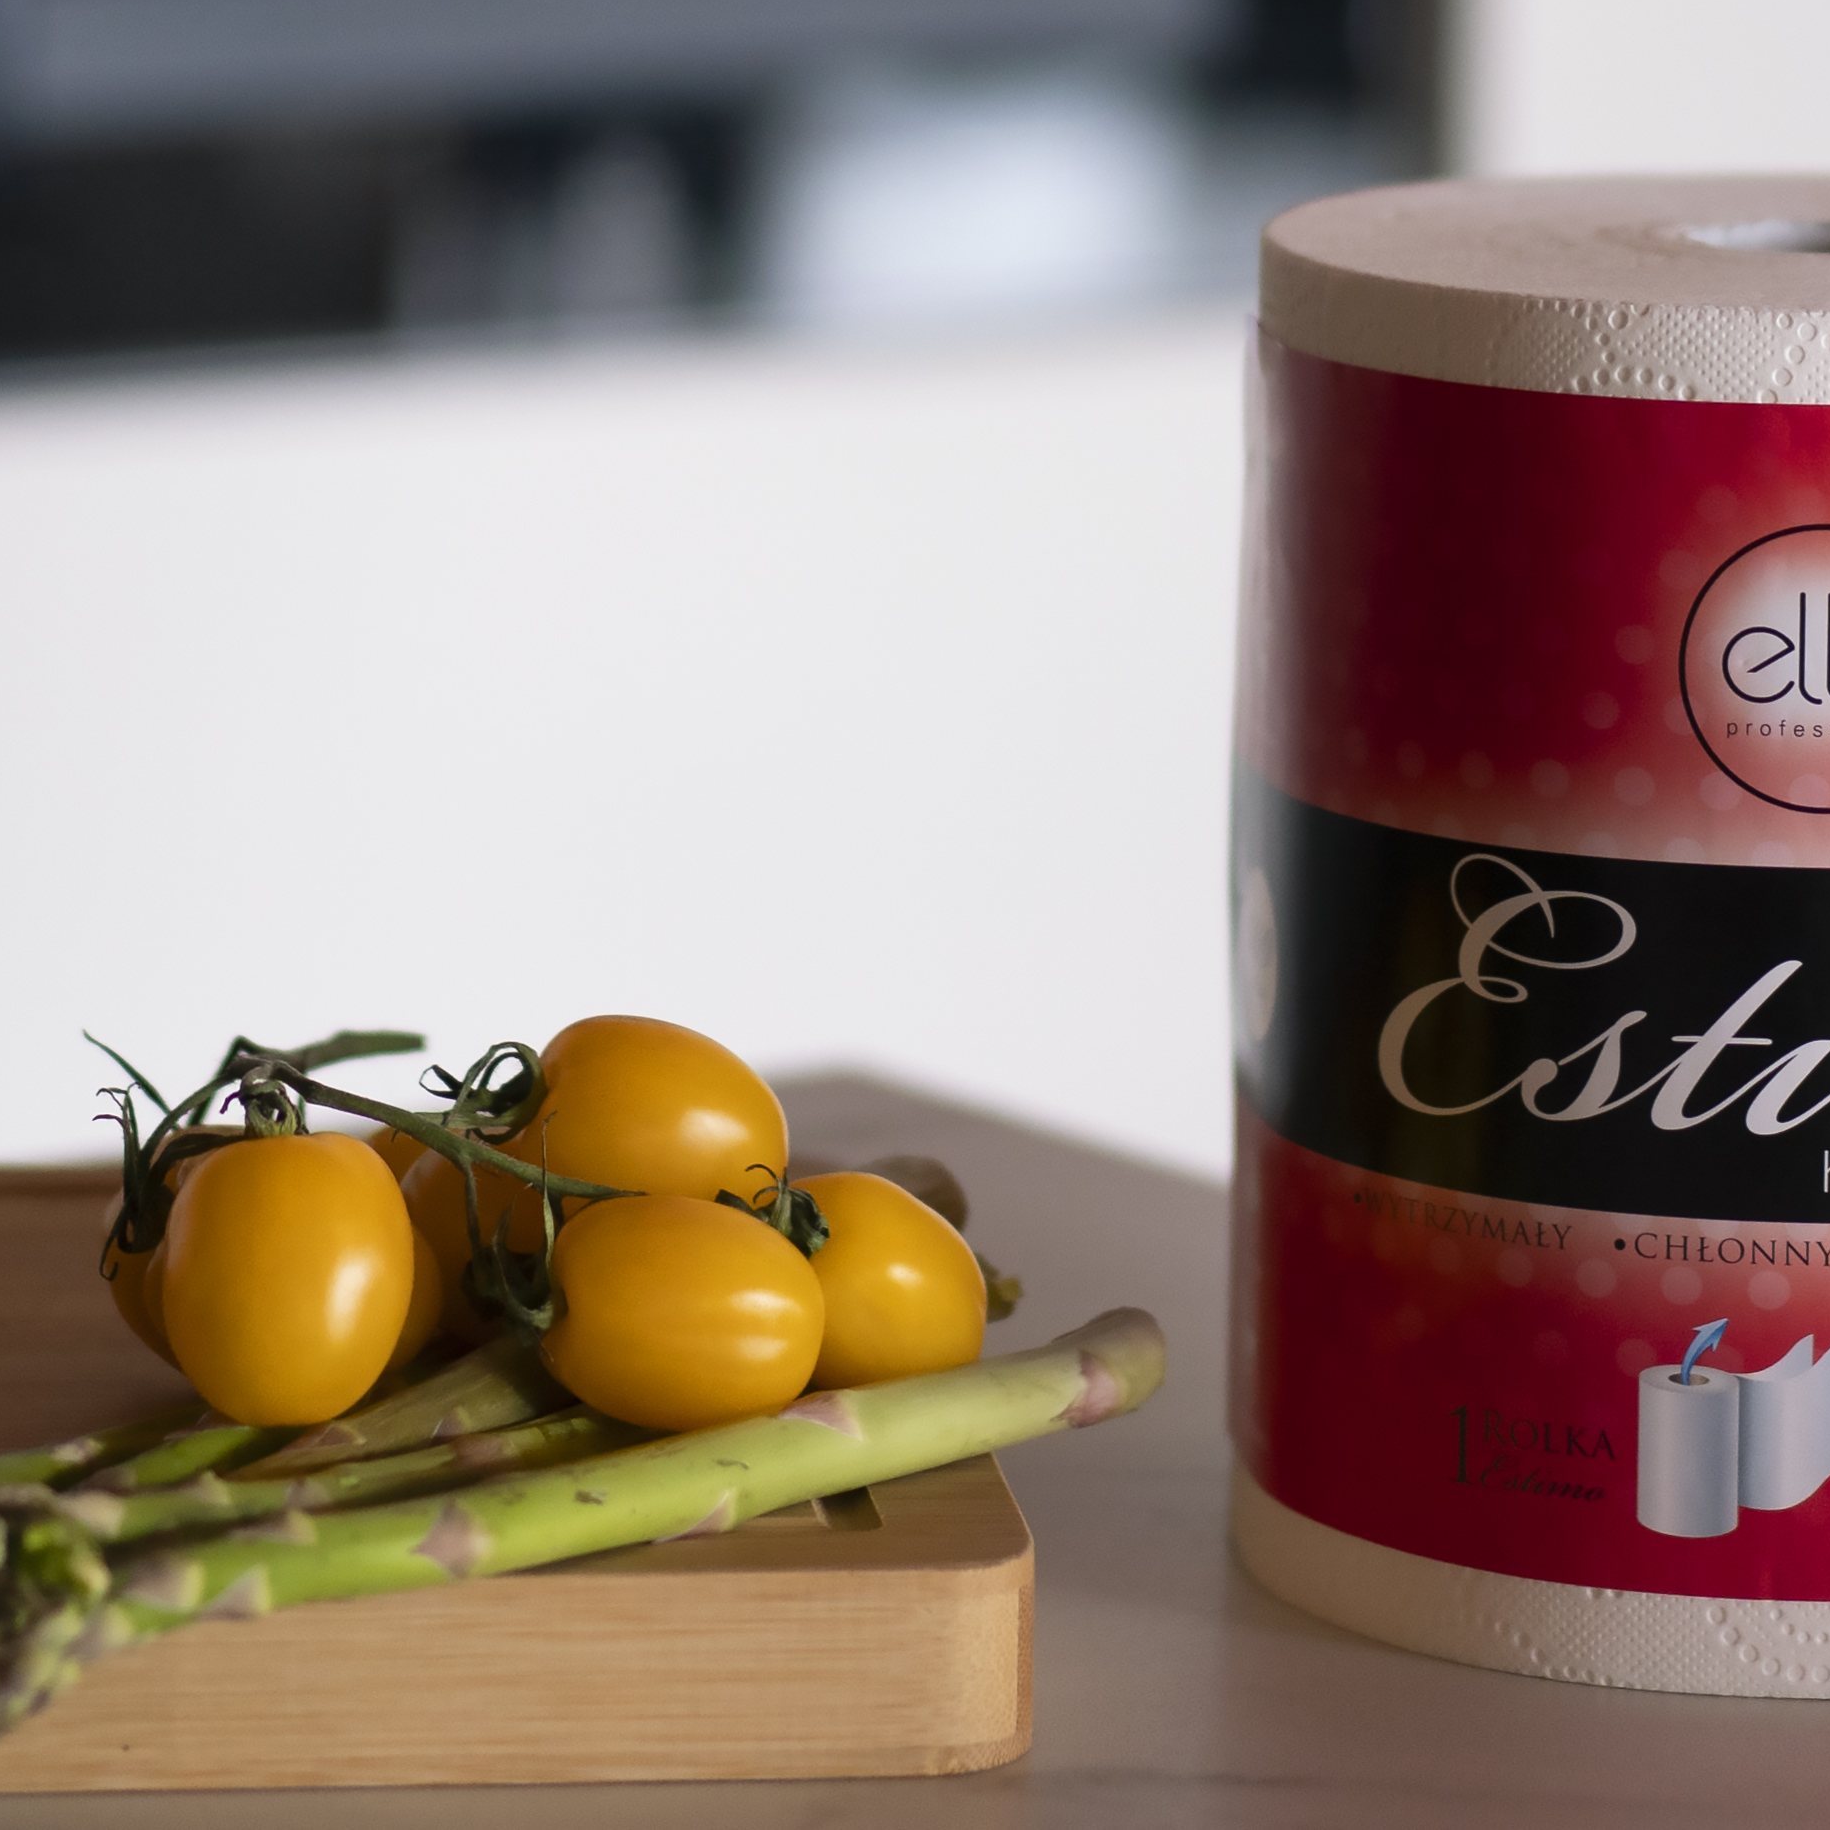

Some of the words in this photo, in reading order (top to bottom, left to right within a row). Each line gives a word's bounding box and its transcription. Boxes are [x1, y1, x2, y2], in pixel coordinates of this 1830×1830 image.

[1363, 1187, 1573, 1250] WYTRZYMAŁY
[1448, 1404, 1475, 1485] 1
[1483, 1407, 1617, 1461] ROLKA
